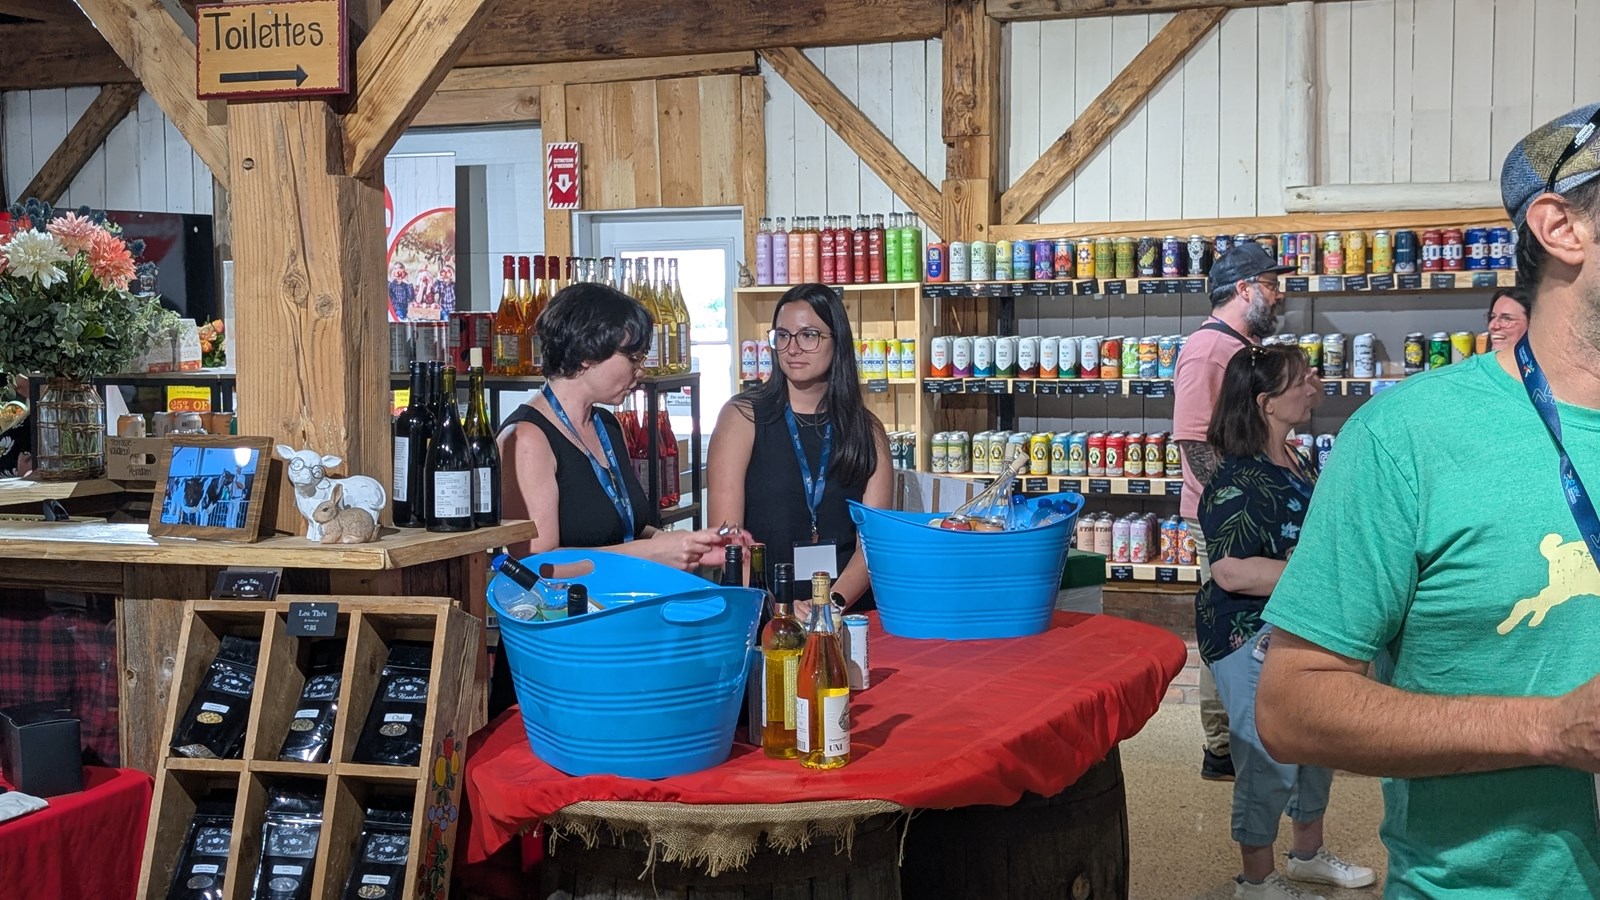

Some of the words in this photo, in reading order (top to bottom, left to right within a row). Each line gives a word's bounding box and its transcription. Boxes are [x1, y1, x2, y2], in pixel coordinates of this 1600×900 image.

[203, 12, 324, 50] Toilettes
[170, 400, 190, 411] 25%
[312, 609, 328, 617] Thés
